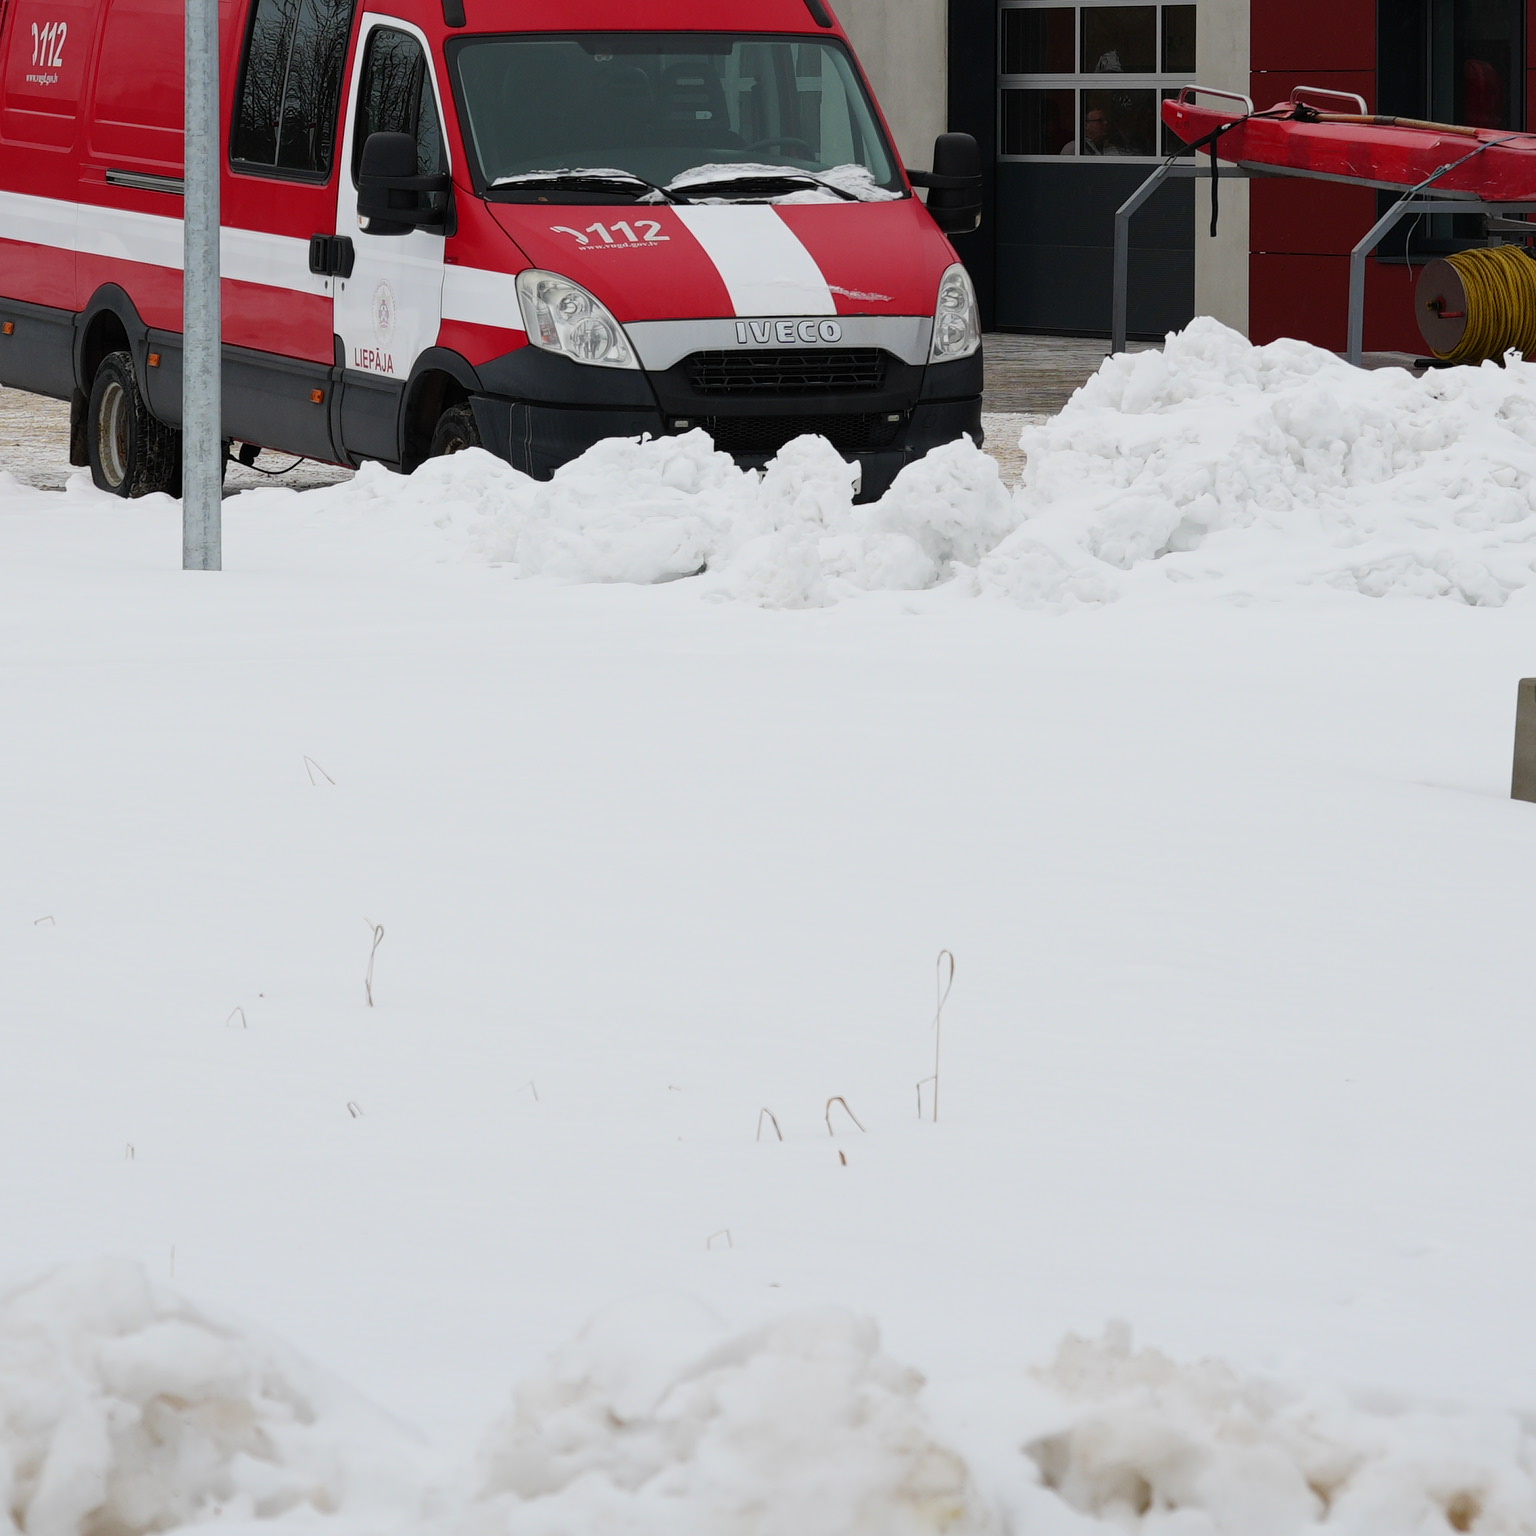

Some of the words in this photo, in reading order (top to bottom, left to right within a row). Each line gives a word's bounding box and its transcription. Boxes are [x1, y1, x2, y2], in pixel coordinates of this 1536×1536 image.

[39, 21, 68, 67] 112
[585, 220, 671, 244] 112
[735, 320, 842, 344] IVECO
[354, 347, 394, 374] LIEPĀJA
